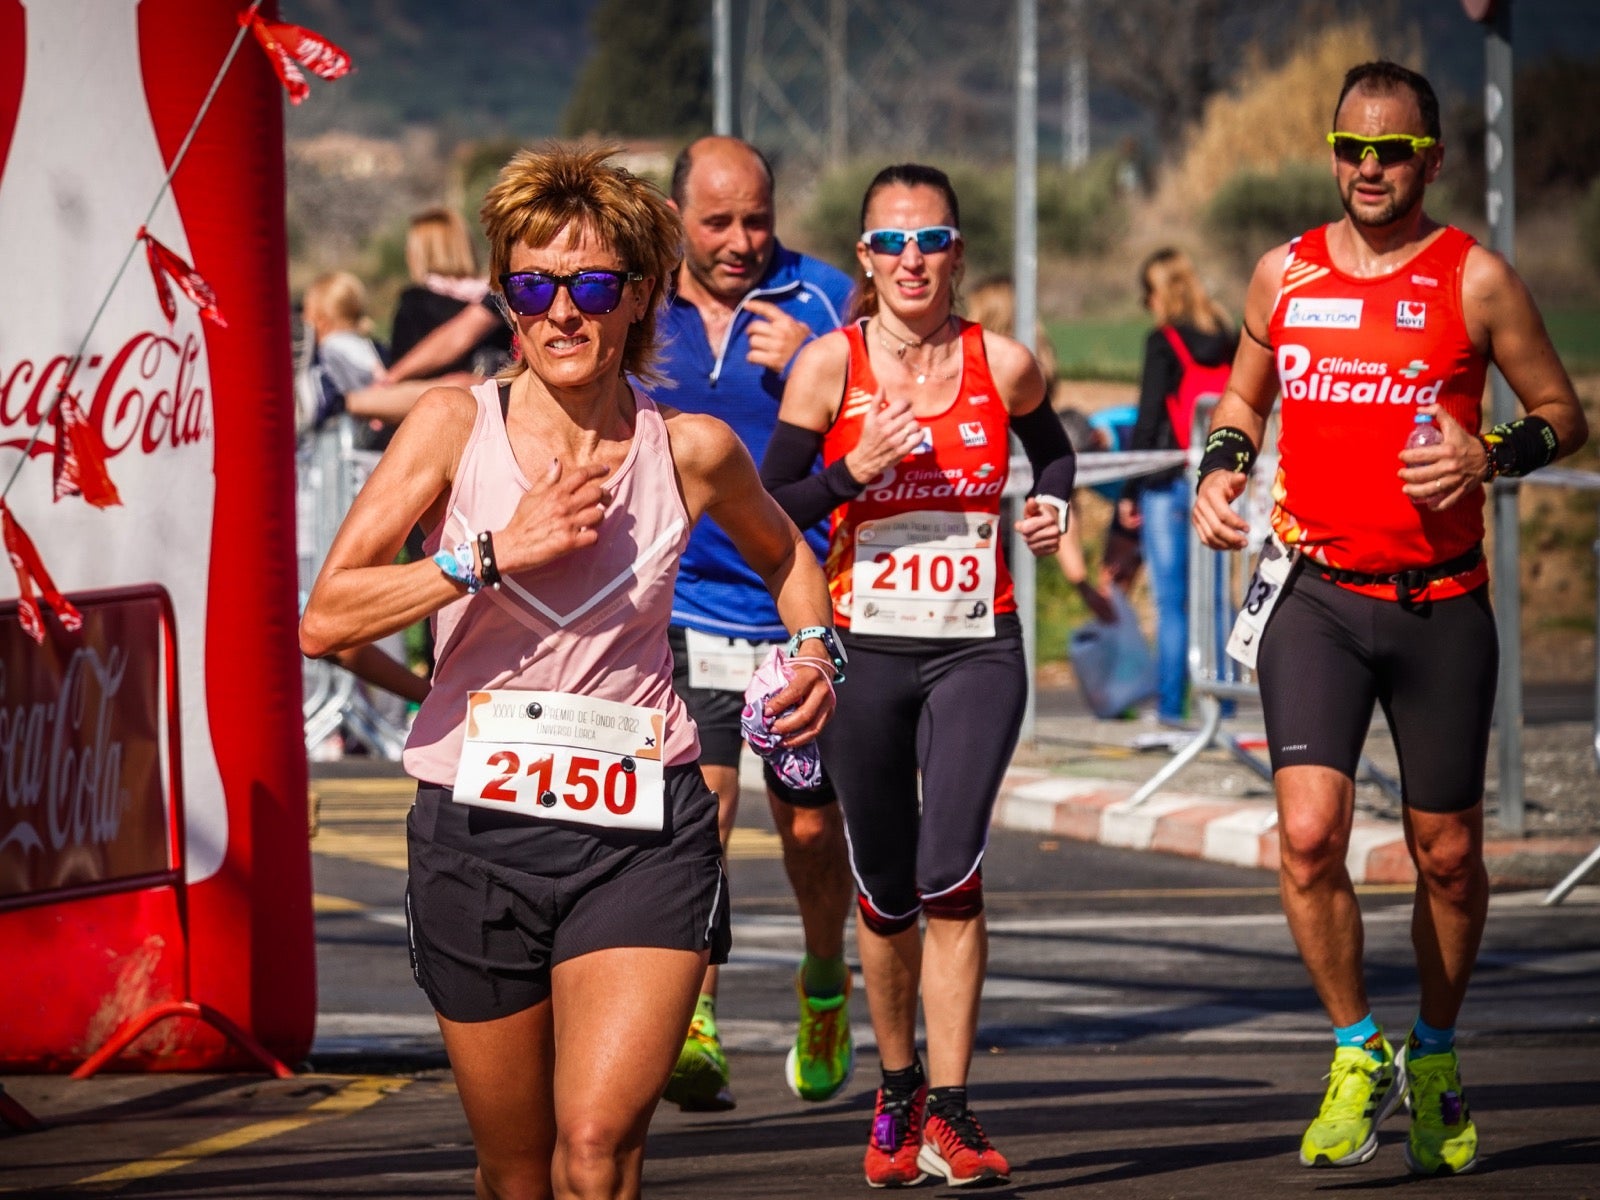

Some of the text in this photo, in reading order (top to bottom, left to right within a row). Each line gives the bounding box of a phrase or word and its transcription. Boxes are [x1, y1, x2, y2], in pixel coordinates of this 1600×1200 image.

[1398, 318, 1422, 326] MOVE
[1278, 344, 1444, 404] Polisalud
[1317, 357, 1388, 376] Clínicas
[872, 552, 980, 592] 2103
[618, 715, 640, 733] 2022
[480, 751, 636, 815] 2150
